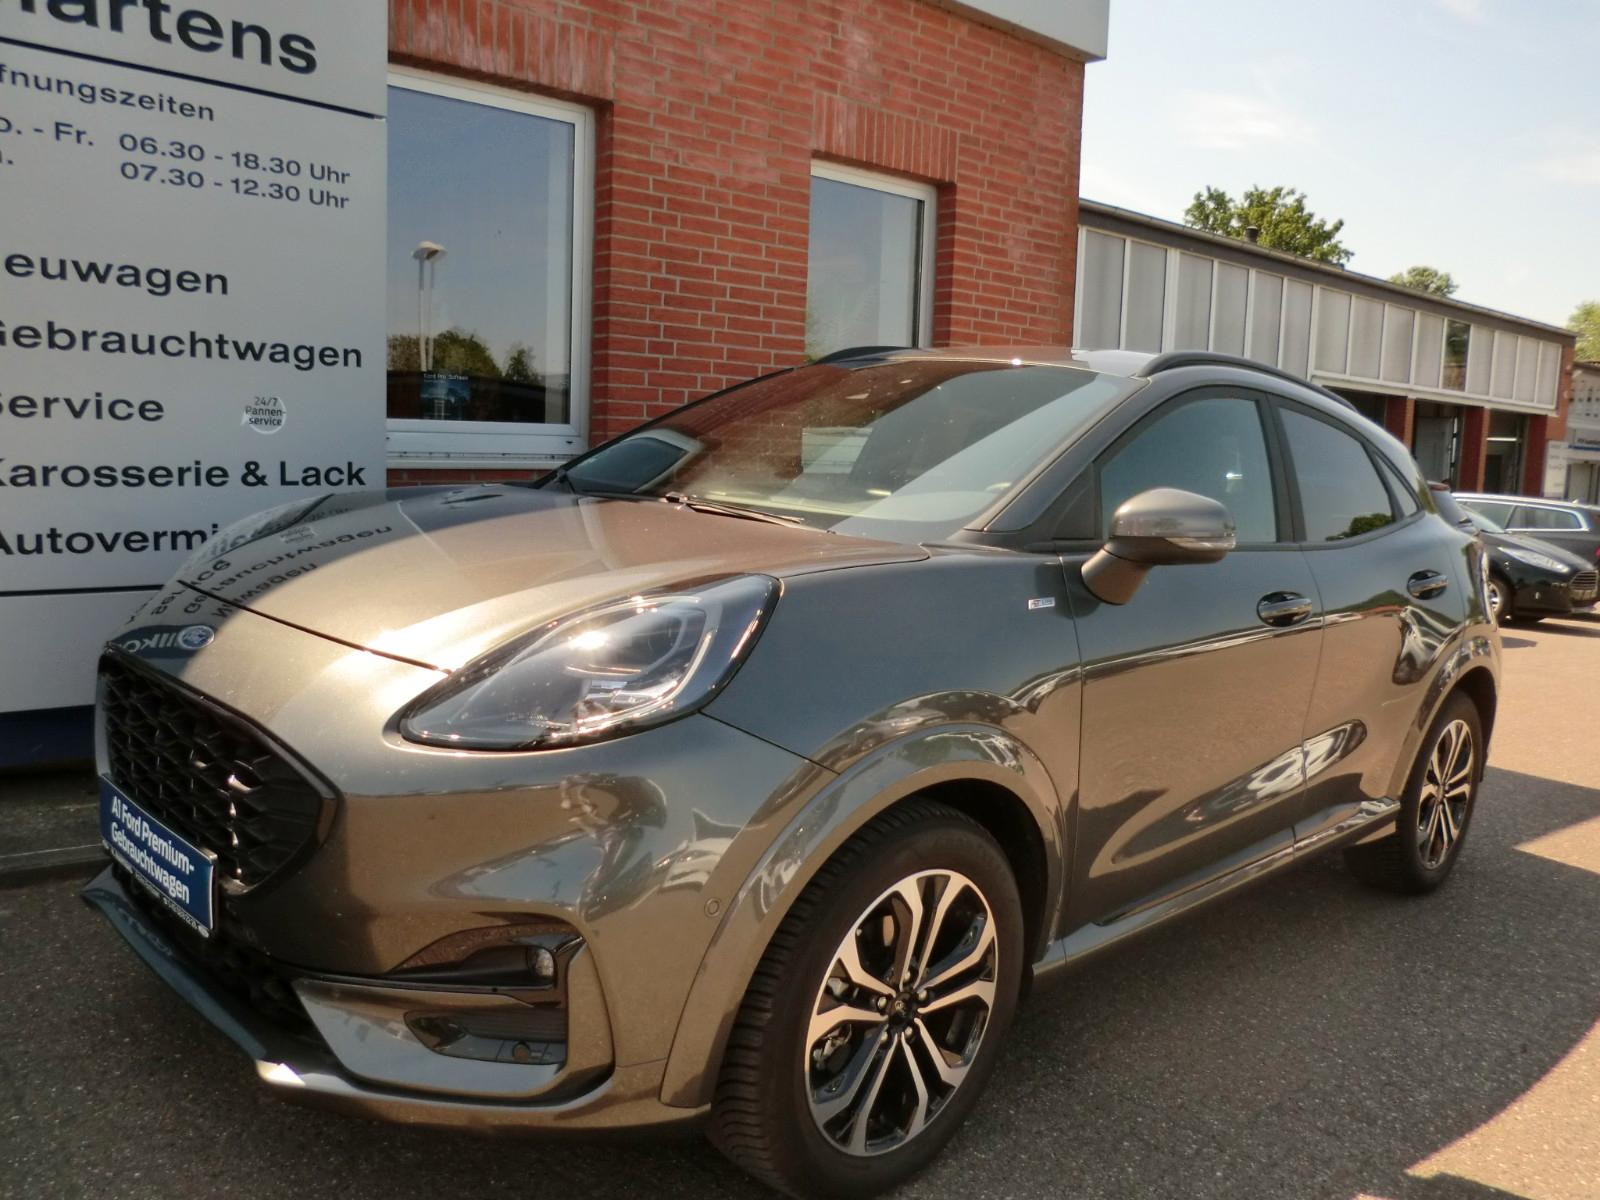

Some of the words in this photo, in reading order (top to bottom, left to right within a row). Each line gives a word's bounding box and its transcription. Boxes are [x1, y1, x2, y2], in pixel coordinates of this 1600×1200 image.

[20, 0, 318, 75] artens
[55, 121, 94, 146] Fr.
[119, 133, 205, 162] 06.30
[231, 151, 301, 177] 18.30
[309, 163, 350, 184] Uhr
[120, 162, 204, 188] 07.30
[231, 178, 300, 202] 12.30
[309, 189, 349, 209] Uhr
[0, 320, 362, 371] ebrauchtwagen
[0, 391, 164, 421] ervice
[248, 416, 282, 426] service
[254, 396, 278, 407] 24/7
[0, 458, 229, 488] arosserie
[240, 460, 268, 488] &
[280, 460, 366, 487] Lack
[111, 821, 190, 904] Gebrauchtwagen
[122, 803, 141, 836] Ford
[142, 820, 195, 876] Premium-
